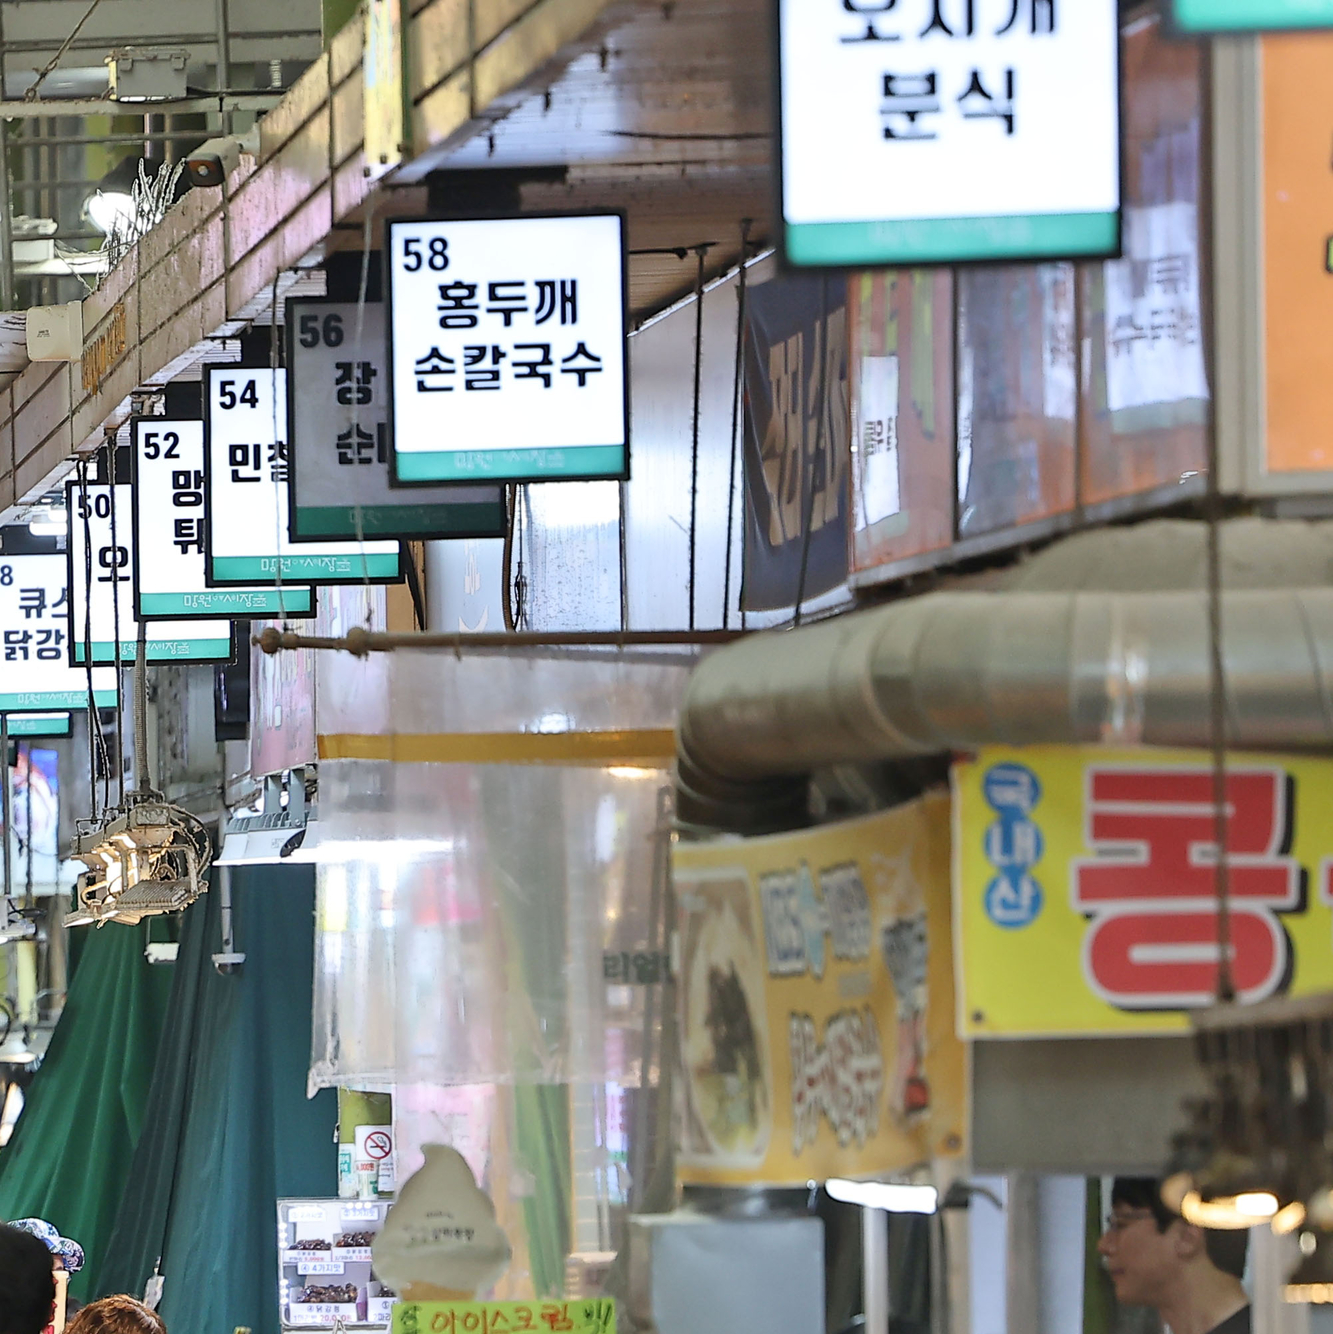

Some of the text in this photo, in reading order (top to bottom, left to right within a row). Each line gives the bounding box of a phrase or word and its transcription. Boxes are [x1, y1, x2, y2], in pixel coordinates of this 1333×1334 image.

[879, 68, 1015, 141] 분식
[402, 237, 451, 272] 58
[437, 278, 579, 330] 홍두깨
[298, 312, 345, 349] 56
[335, 361, 378, 406] 장
[413, 340, 604, 393] 손칼국수
[218, 379, 260, 410] 54
[143, 431, 181, 460] 52
[336, 422, 388, 466] 순
[78, 493, 111, 519] 50
[97, 546, 131, 582] 오
[986, 766, 1041, 924] 국내산
[1071, 764, 1333, 1009] 콩
